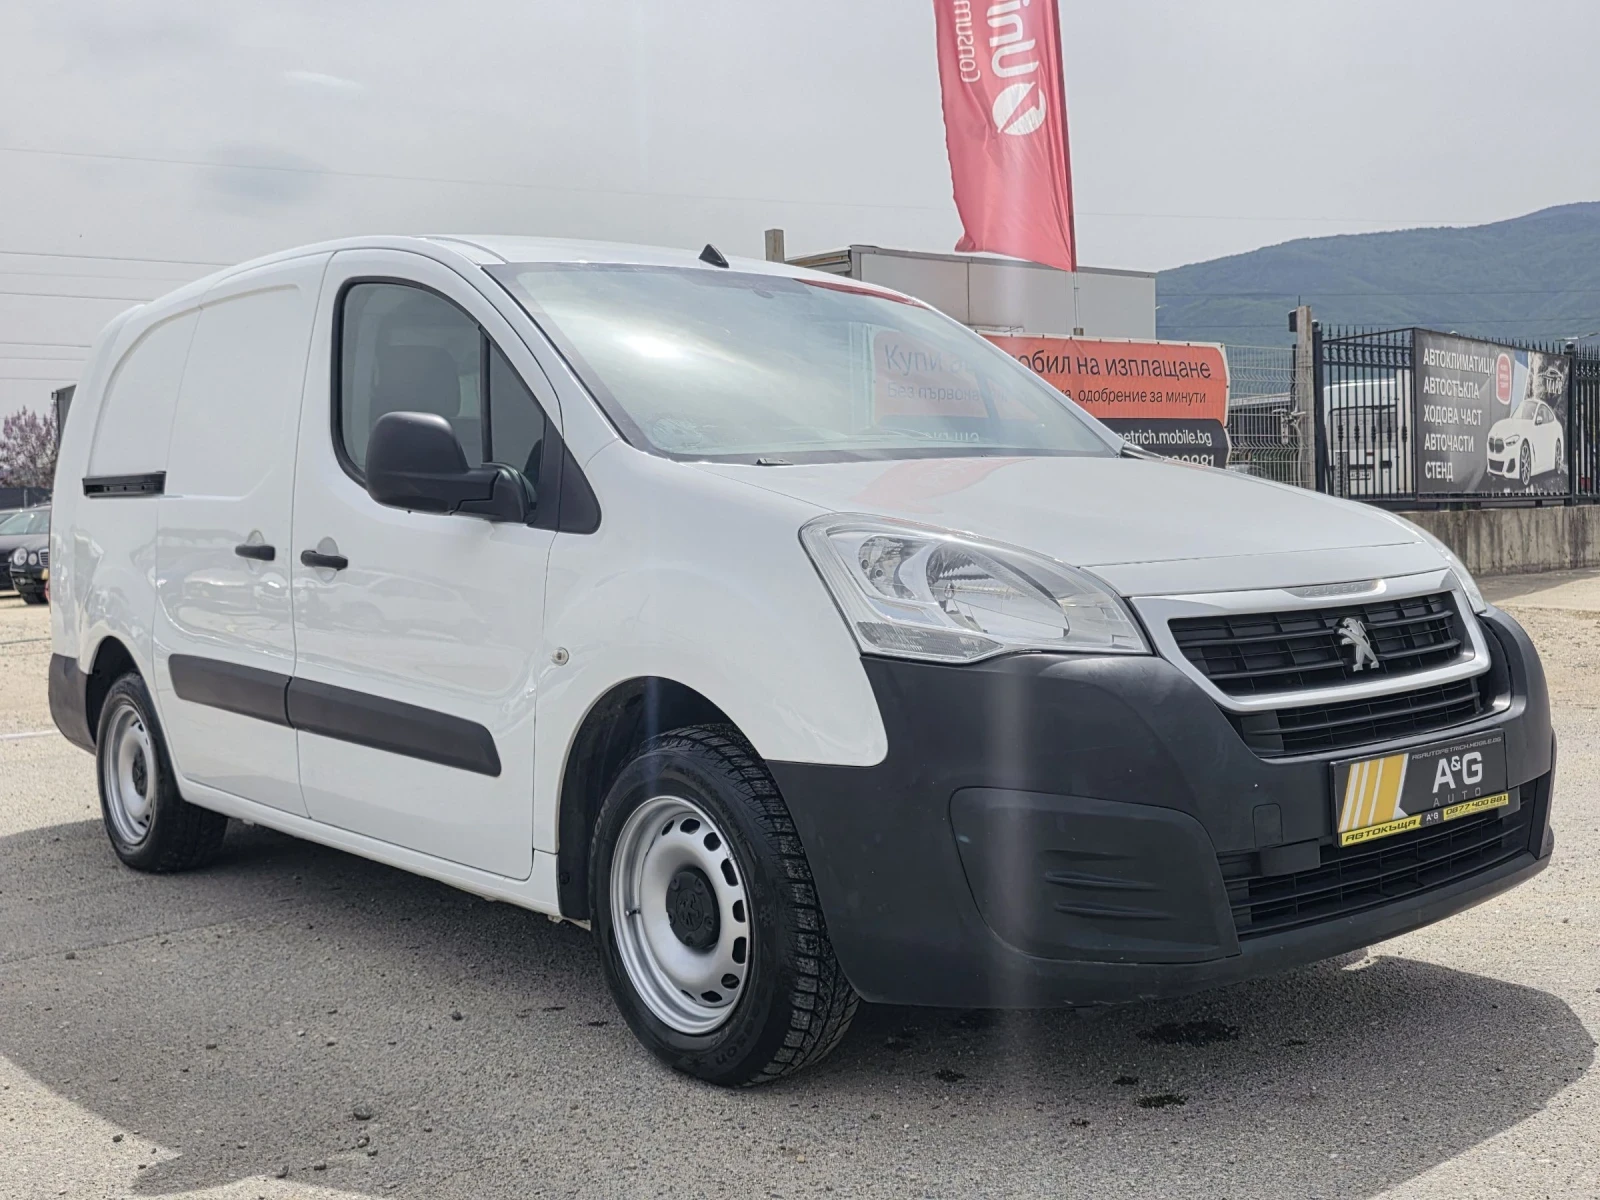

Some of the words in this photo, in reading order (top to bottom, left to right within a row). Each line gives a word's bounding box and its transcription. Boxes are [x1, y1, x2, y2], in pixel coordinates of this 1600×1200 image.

[1076, 356, 1101, 375] на
[1105, 358, 1211, 381] изплащане
[1423, 348, 1495, 376] АВТОКЛИМАТИЦИ
[918, 387, 981, 403] първона
[1078, 388, 1147, 405] одобрение
[1149, 391, 1163, 403] за
[1165, 391, 1206, 406] минути
[1423, 377, 1480, 399] АВТОСТЪКЛА
[1423, 405, 1460, 427] ХОДОВА
[1460, 409, 1482, 426] ЧАСТ
[1424, 433, 1474, 453] АВТОЧАСТИ
[1425, 461, 1454, 482] СТЕНД
[1303, 582, 1365, 597] PEUGEOT
[1432, 751, 1483, 794] A&G
[1433, 786, 1481, 808] AUTO
[1446, 803, 1470, 816] 0877
[1472, 798, 1489, 808] 400
[1345, 819, 1417, 842] АВТОКЪЩА
